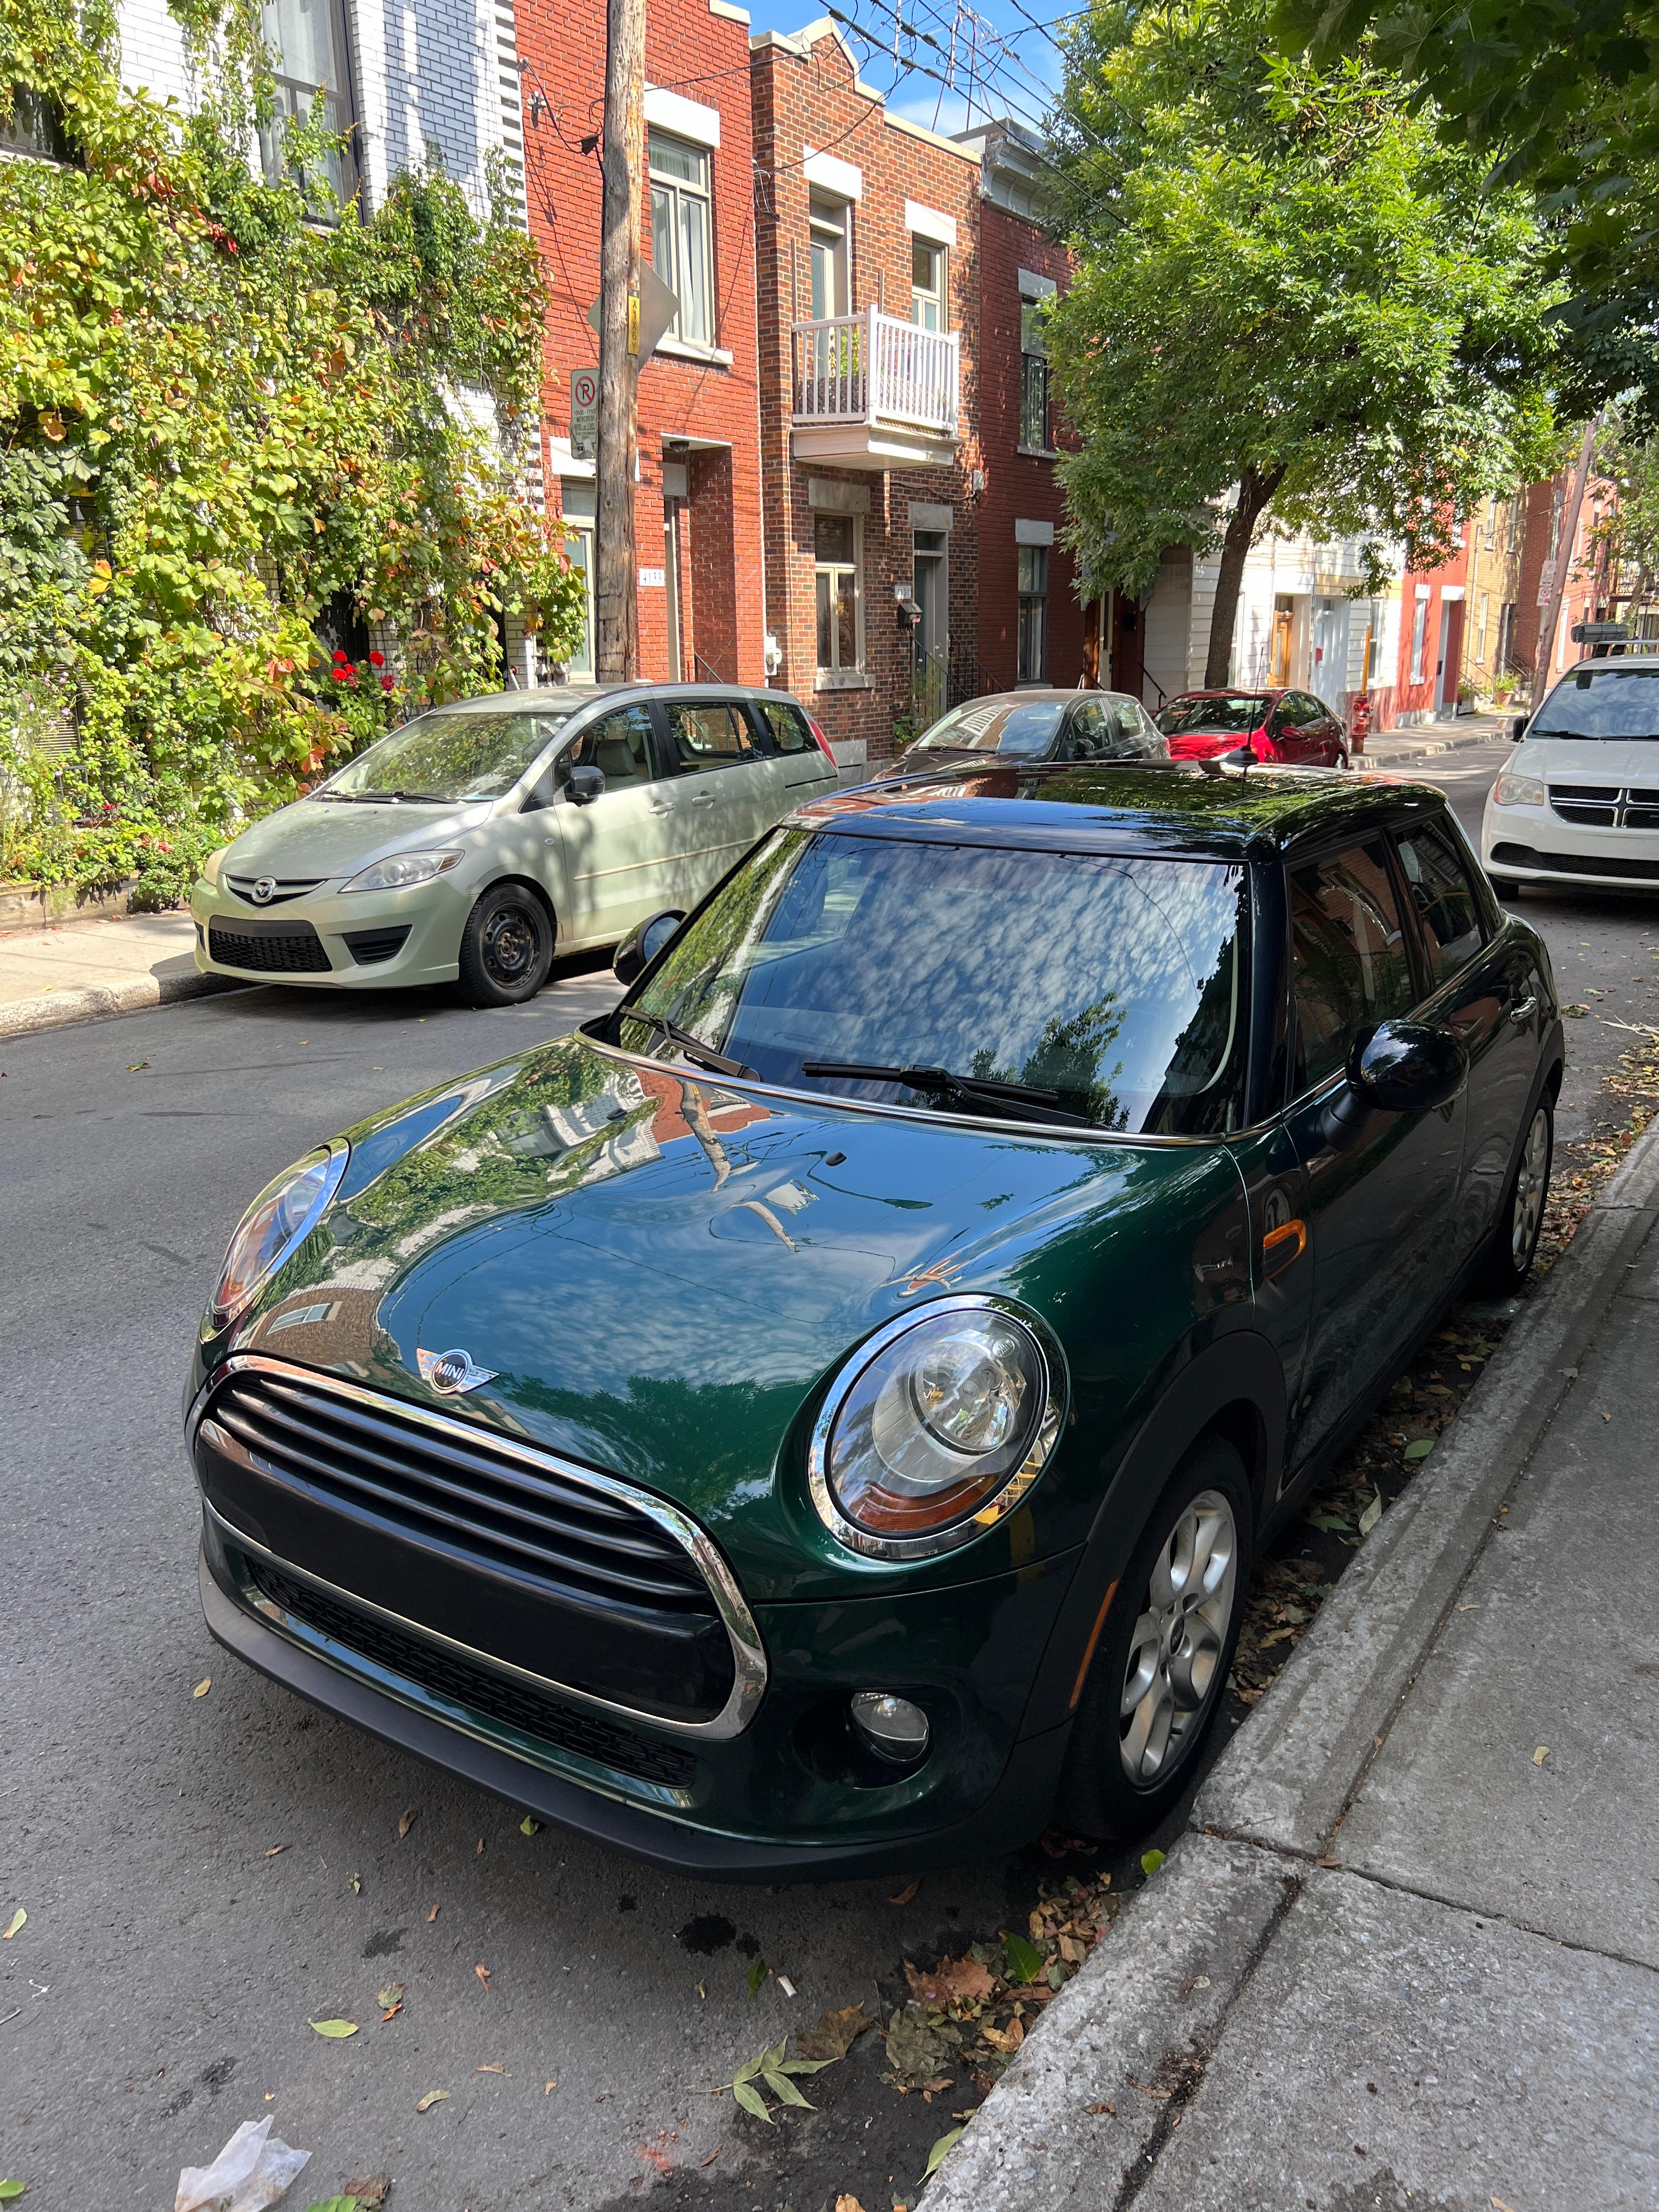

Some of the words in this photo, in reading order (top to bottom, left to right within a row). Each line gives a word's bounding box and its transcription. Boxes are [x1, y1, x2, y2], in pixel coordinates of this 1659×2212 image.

[643, 572, 662, 584] 4133
[897, 588, 910, 597] 4131
[435, 1361, 465, 1380] MINI
